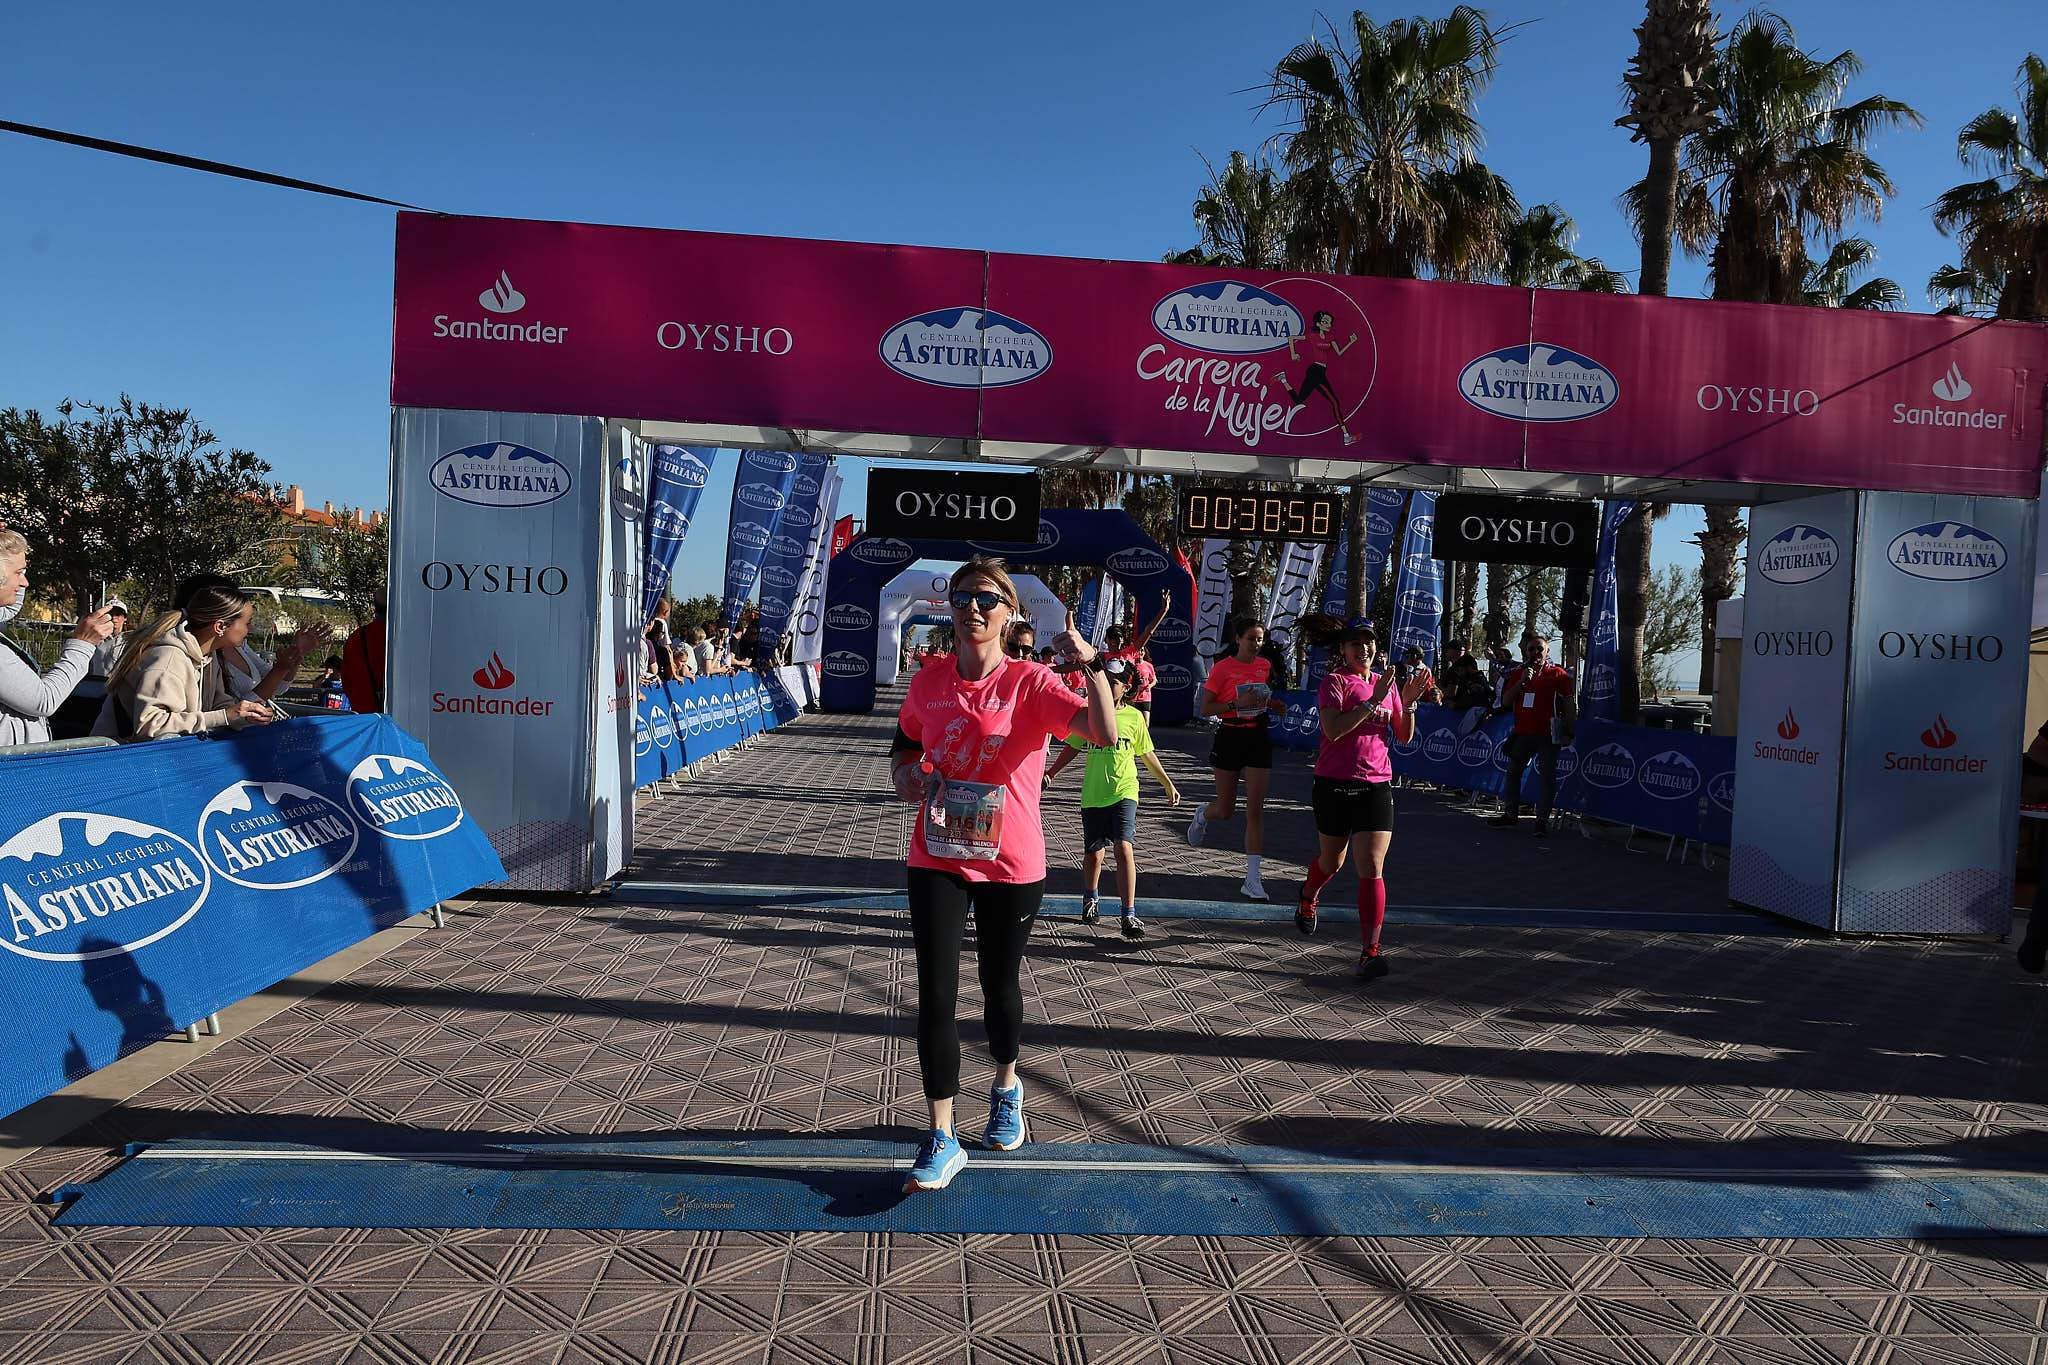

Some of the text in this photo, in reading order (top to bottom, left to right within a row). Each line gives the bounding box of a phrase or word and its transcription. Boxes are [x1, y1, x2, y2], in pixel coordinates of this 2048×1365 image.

[1165, 303, 1291, 339] ASTURIANA
[1188, 303, 1288, 318] CENTRAL LECHERA
[433, 315, 568, 345] Santander
[657, 321, 793, 355] OYSHO
[920, 333, 1035, 346] CENTRAL ECHERA
[892, 333, 1039, 371] ASTURIANA
[1136, 344, 1262, 386] Carrera
[1470, 369, 1606, 404] ASTURIANA
[1496, 367, 1602, 382] CENTRAL LECHERA
[1697, 384, 1820, 416] OYSHO
[1164, 385, 1307, 447] de la Mujer
[1892, 403, 2008, 430] Santander
[462, 463, 558, 474] CENTRAL LECHERA
[749, 450, 792, 470] ASTURIANA
[439, 463, 561, 493] ASTURIANA
[896, 491, 1017, 521] OYSHO
[1189, 495, 1330, 534] 00:38:58
[1460, 516, 1575, 546] OYSHO
[854, 545, 909, 560] ASTURIANA
[1110, 557, 1165, 570] ASTURIANA
[1762, 542, 1833, 573] ASTURIANA
[1895, 537, 1998, 569] ASTURIANA
[422, 561, 568, 596] OYSHO
[827, 614, 870, 626] ASTURIANA
[1150, 626, 1190, 638] STURIANA
[1754, 630, 1834, 657] OYSHO
[1878, 631, 2004, 663] OYSHO
[824, 659, 866, 672] ASTURIANA
[432, 692, 553, 716] Santander
[1754, 741, 1820, 765] Santander
[1884, 752, 1988, 773] Santander
[1583, 757, 1631, 780] ASTURIANA
[1641, 767, 1693, 791] ASTURIANA
[369, 781, 407, 796] CENTRAL
[231, 801, 327, 834] CENTRAL LECHERA
[215, 813, 353, 875] ASTURIANA
[27, 840, 175, 888] CENTRAL LECHERA
[2, 857, 203, 944] ASTURIANA
